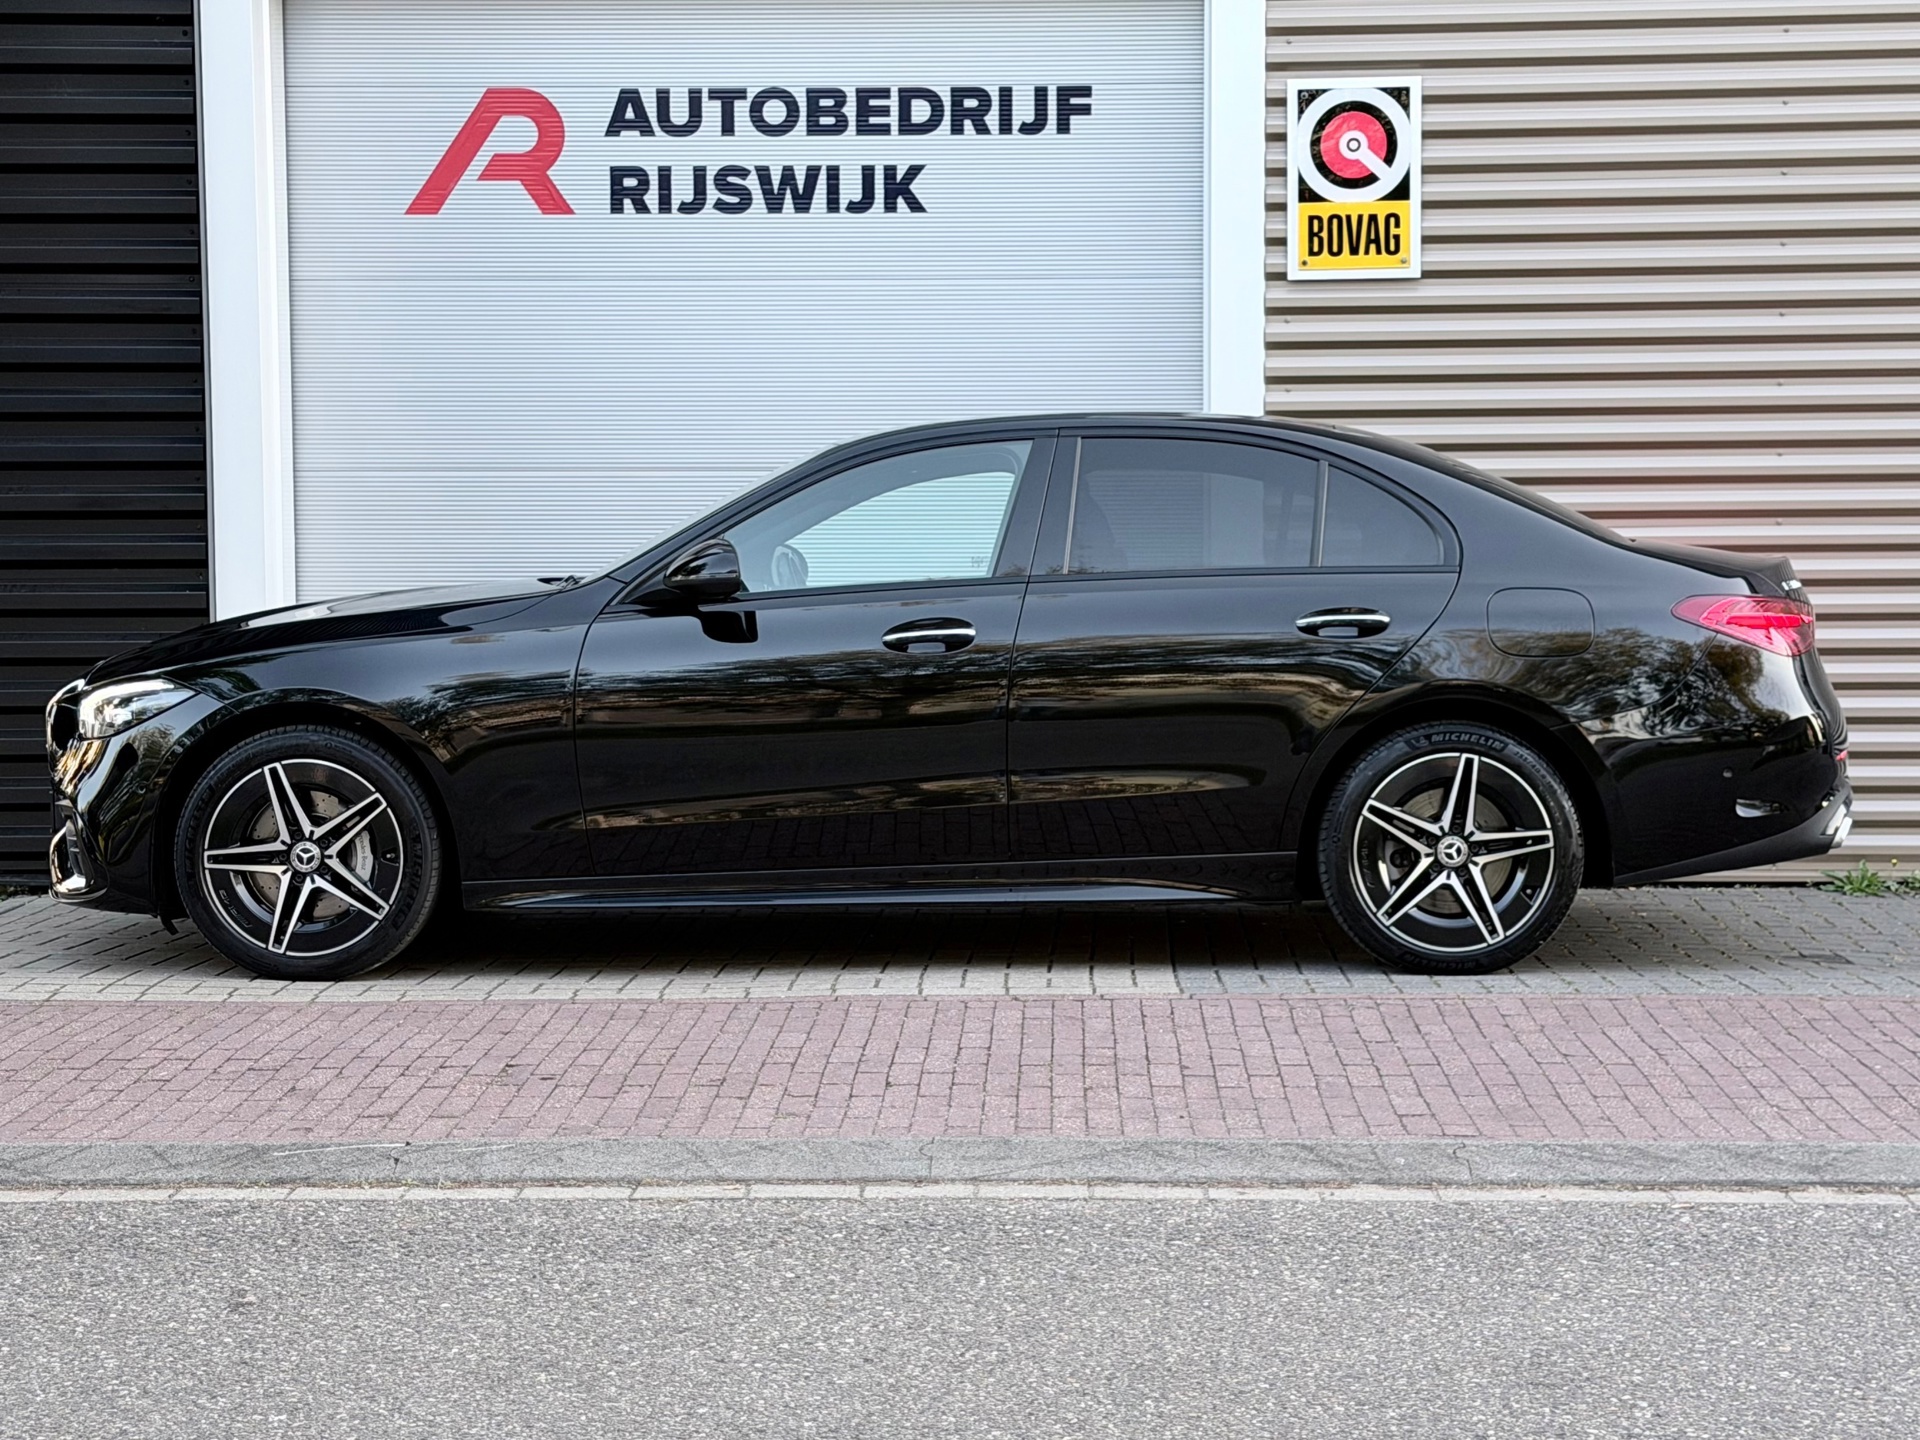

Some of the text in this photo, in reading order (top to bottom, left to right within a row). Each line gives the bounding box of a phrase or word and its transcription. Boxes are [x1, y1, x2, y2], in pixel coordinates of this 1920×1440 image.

[604, 85, 1093, 137] AUTOBEDRIJF
[609, 164, 929, 215] RIJSWIJK
[1307, 212, 1401, 258] BOVAG
[1431, 732, 1505, 751] MICHELIN
